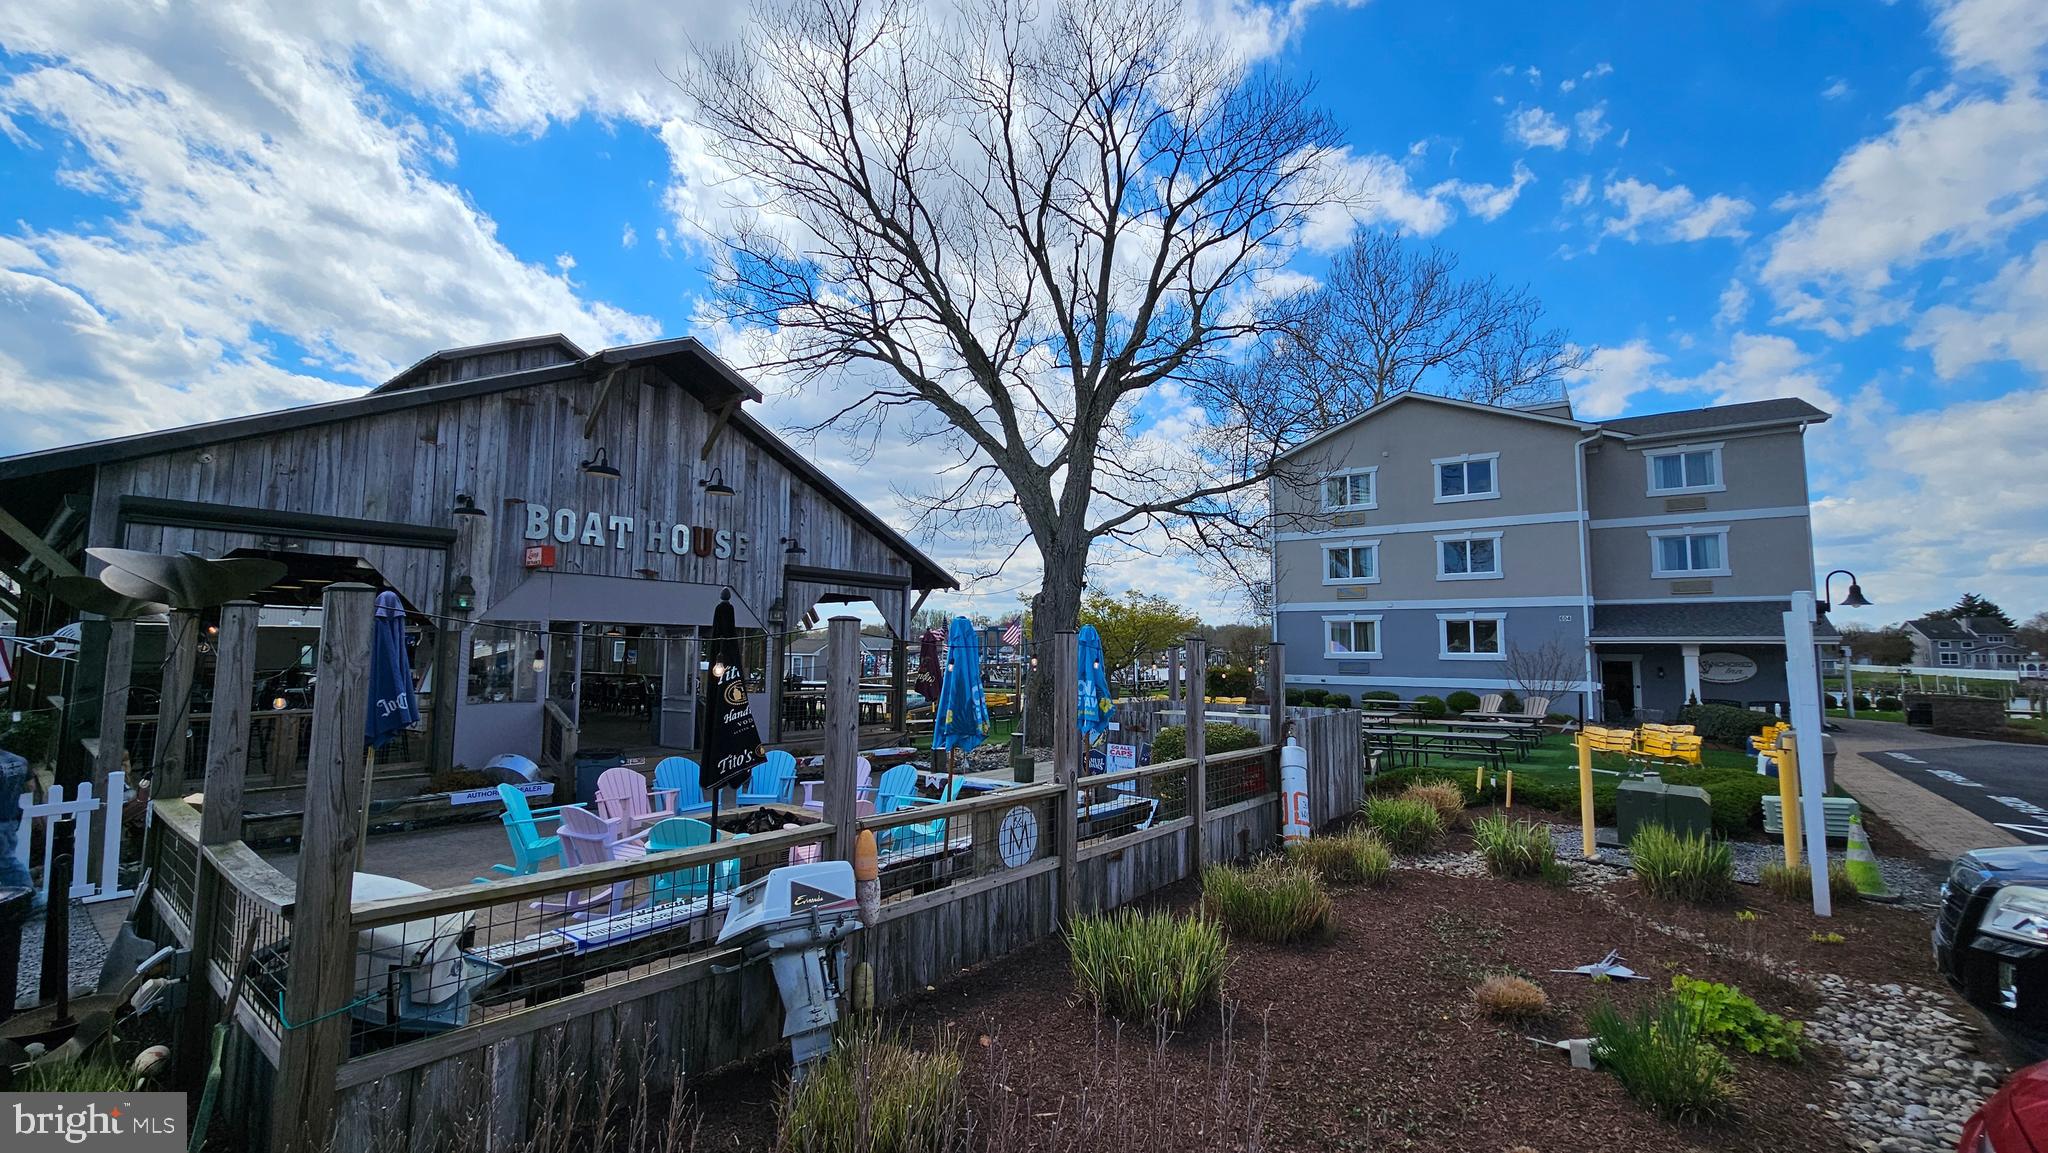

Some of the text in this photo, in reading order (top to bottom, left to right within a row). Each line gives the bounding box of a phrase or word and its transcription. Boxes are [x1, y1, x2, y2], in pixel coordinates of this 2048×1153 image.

[525, 503, 750, 562] BOAT HOUSE
[717, 749, 753, 775] Tito's
[1109, 749, 1133, 757] CAPS
